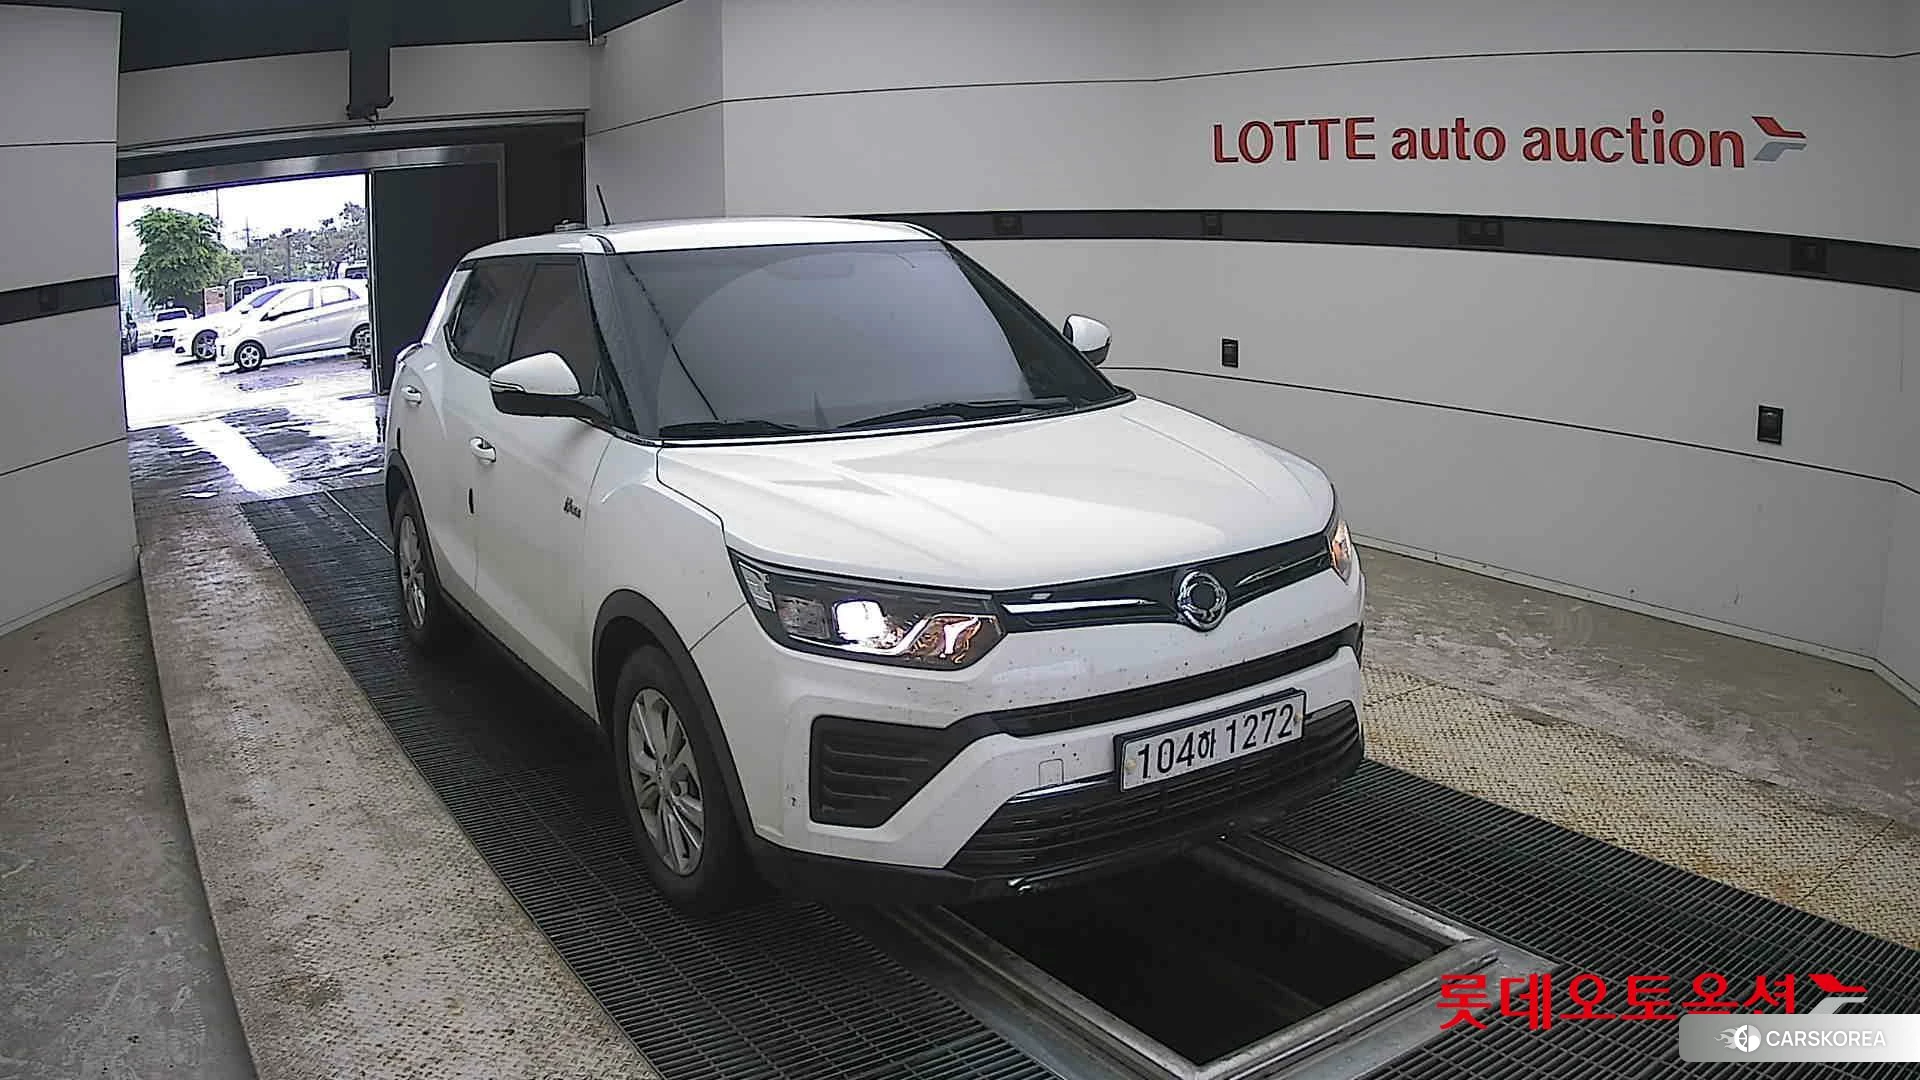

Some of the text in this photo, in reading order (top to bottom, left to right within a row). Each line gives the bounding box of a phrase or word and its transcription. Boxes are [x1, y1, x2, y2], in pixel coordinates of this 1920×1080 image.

[1213, 109, 1745, 168] LOTTE auto auction
[1137, 703, 1294, 779] 104하 1272
